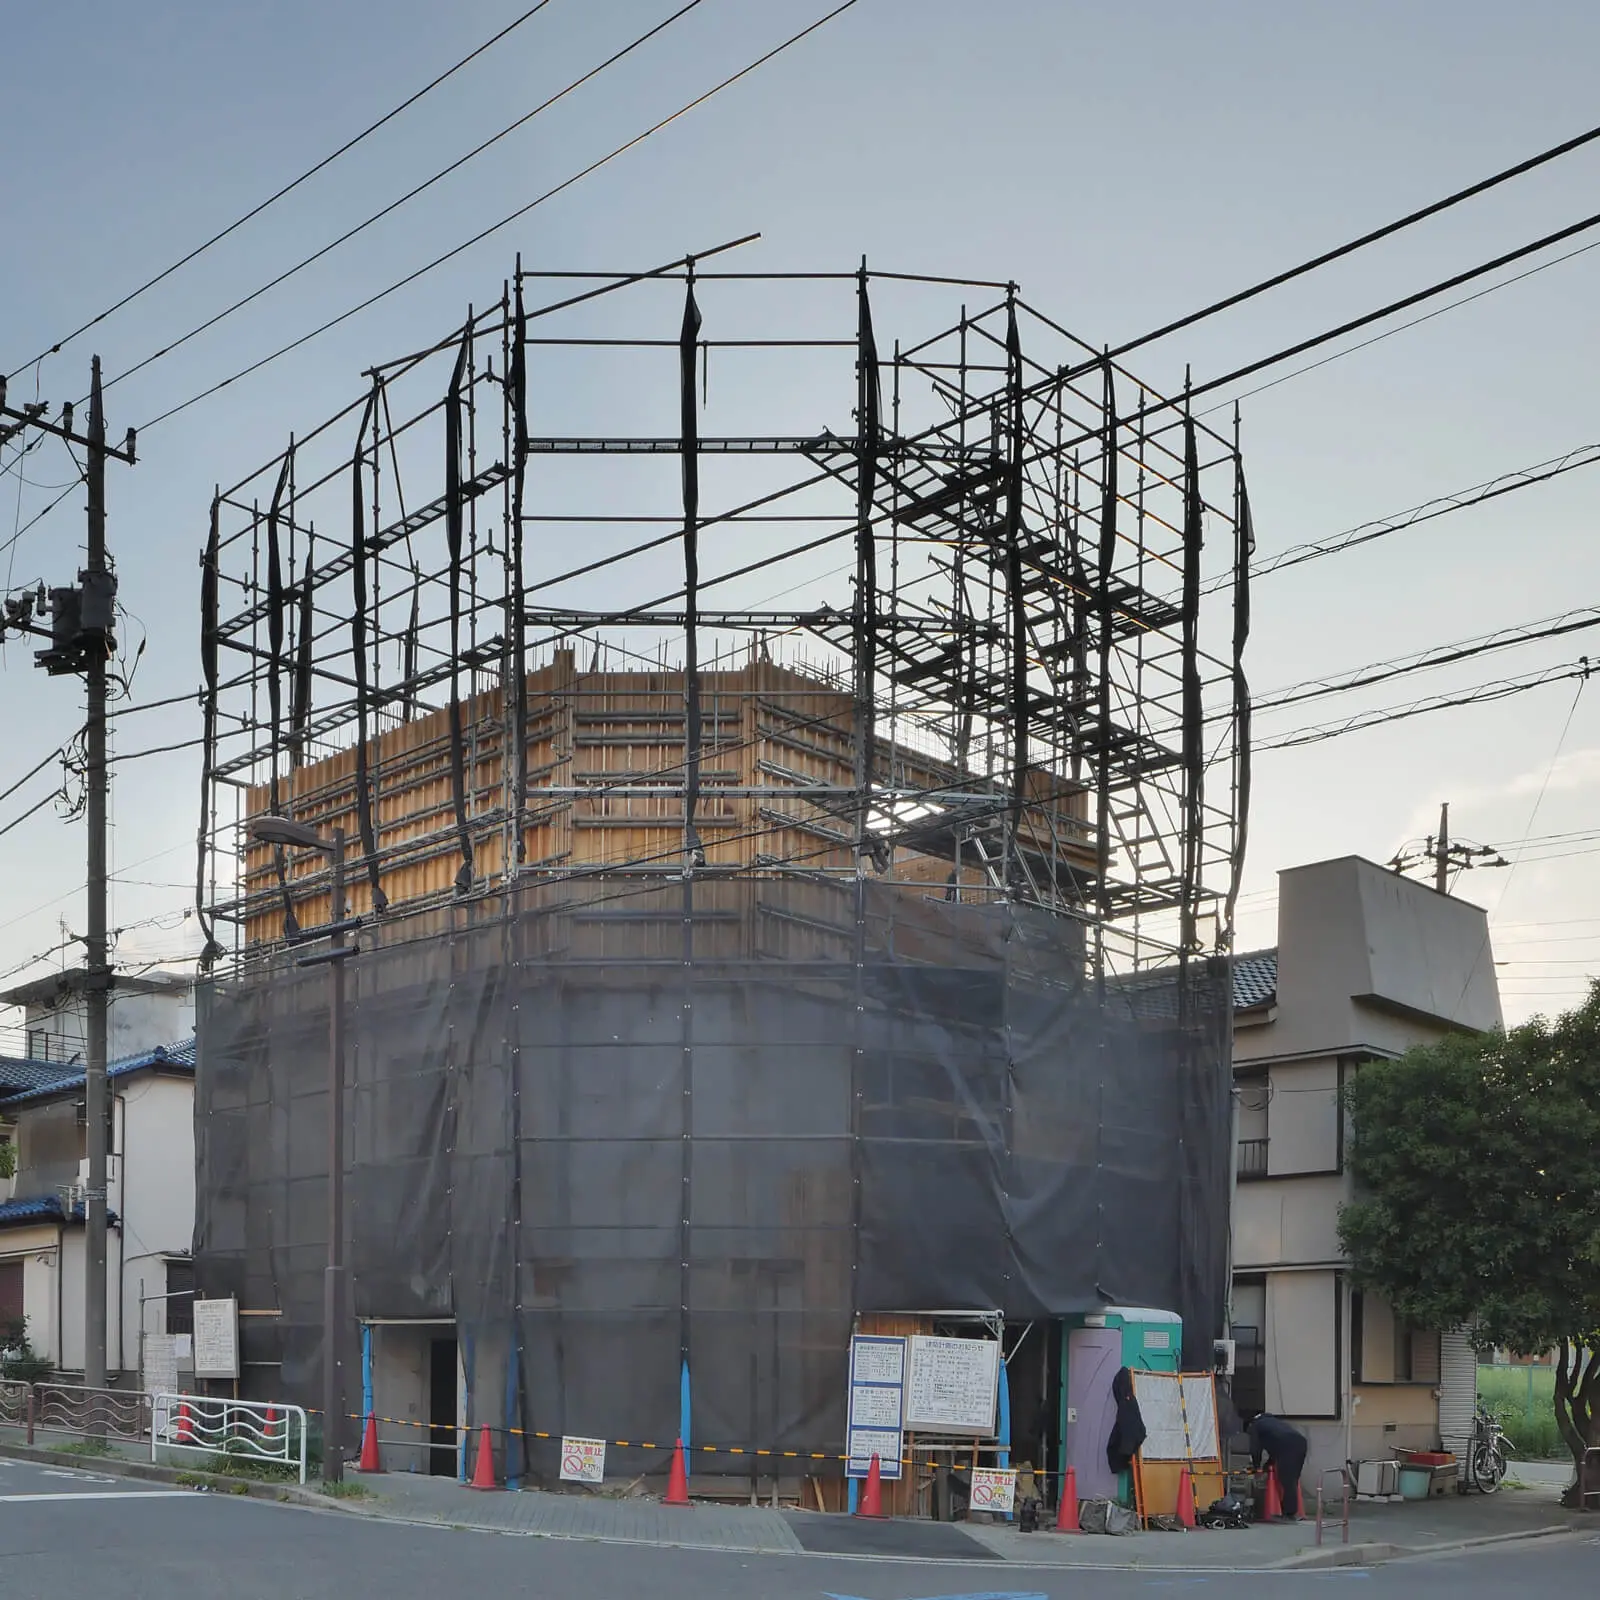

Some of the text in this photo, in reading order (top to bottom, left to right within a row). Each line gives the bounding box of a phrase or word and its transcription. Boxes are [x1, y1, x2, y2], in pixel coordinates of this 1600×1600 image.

[564, 1445, 603, 1456] 立入禁止
[974, 1475, 1013, 1486] 立入禁止
